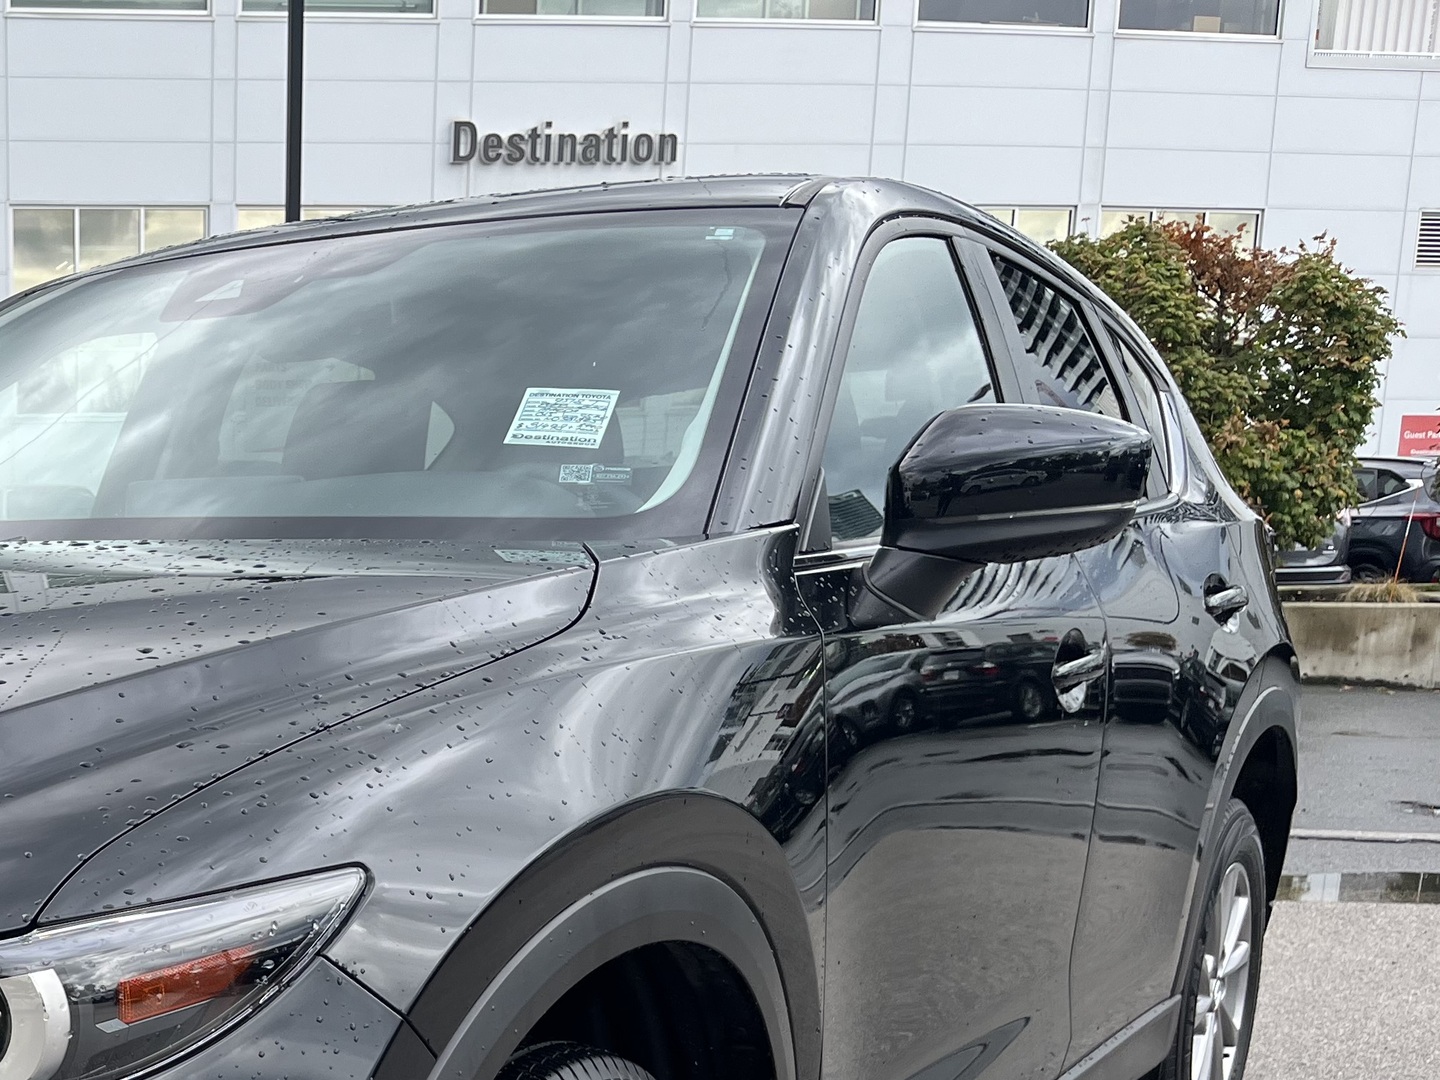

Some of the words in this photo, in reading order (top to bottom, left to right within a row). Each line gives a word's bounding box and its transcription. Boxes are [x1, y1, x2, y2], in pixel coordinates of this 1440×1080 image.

[450, 120, 678, 164] Destination
[511, 433, 597, 443] Destination
[1404, 430, 1426, 439] Guest
